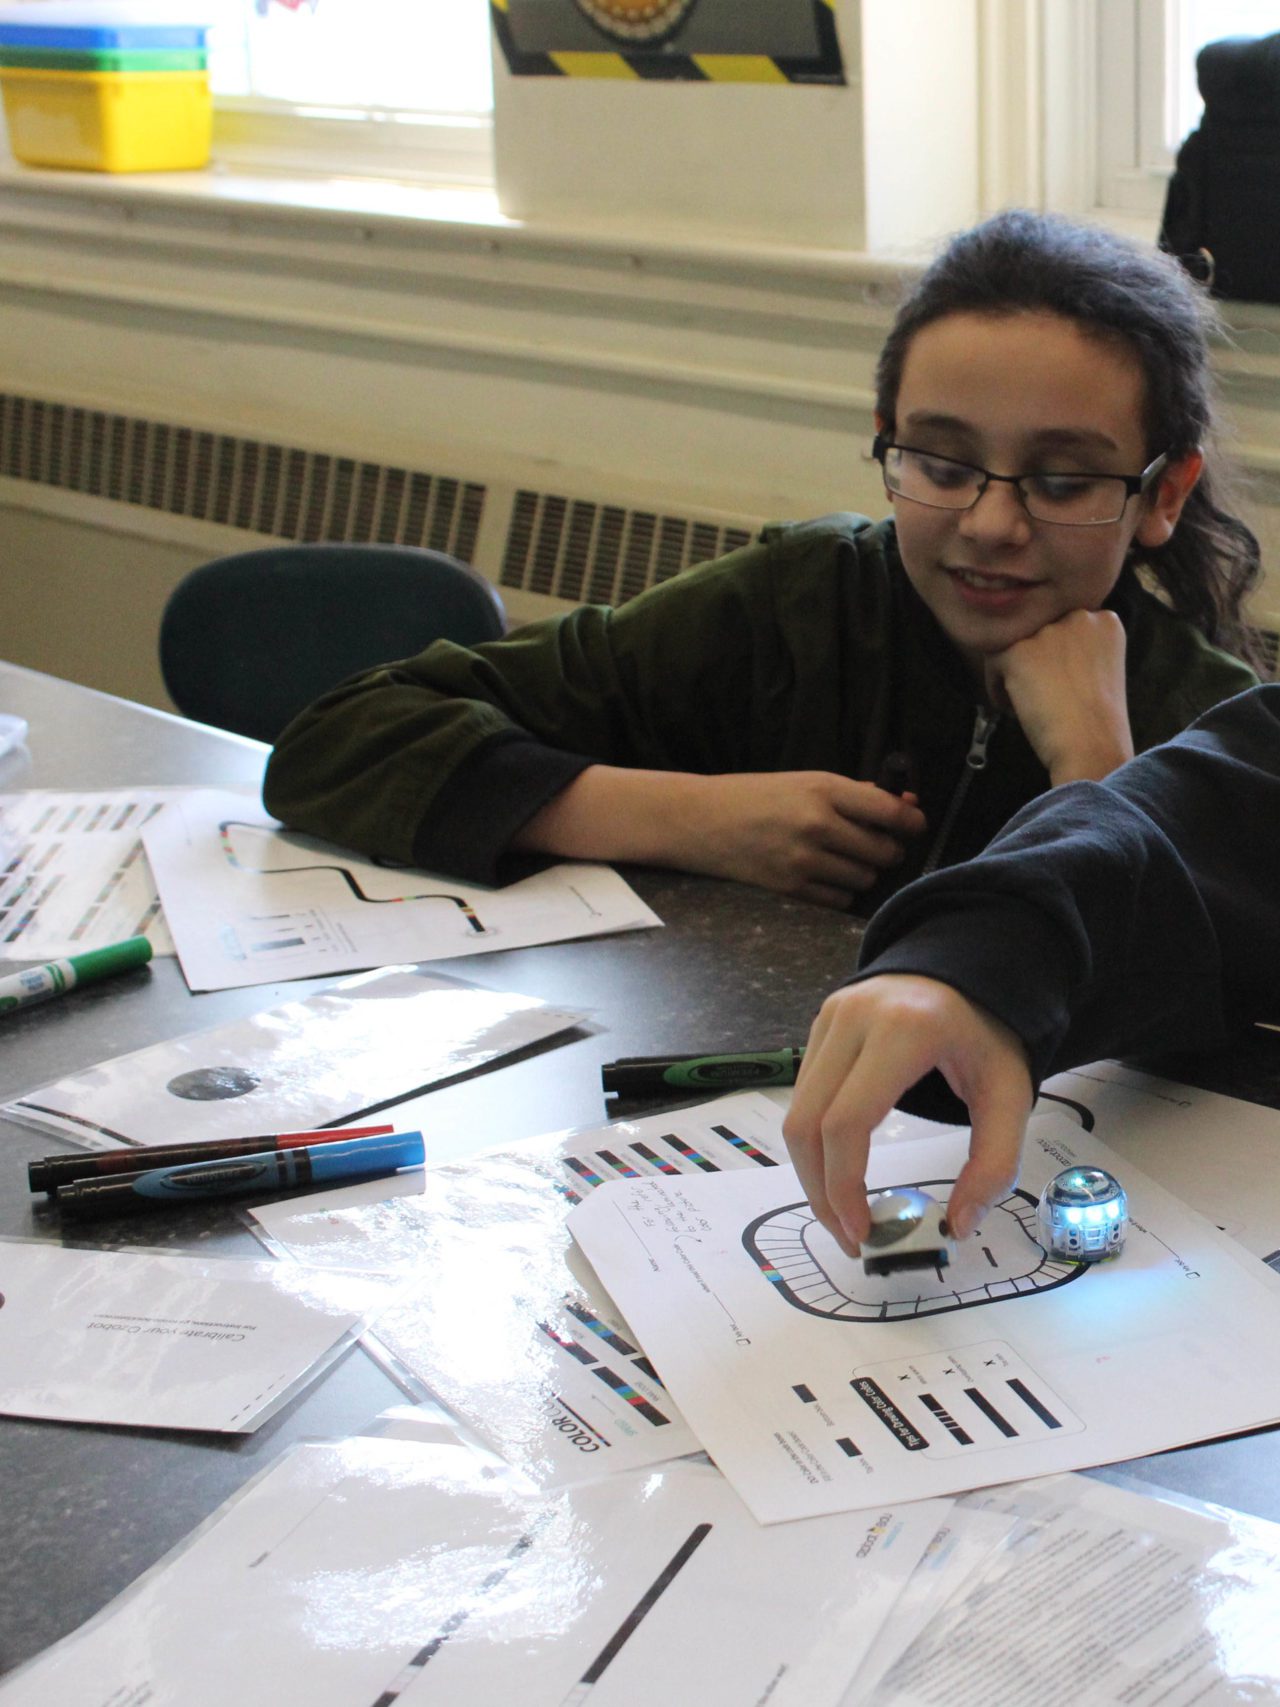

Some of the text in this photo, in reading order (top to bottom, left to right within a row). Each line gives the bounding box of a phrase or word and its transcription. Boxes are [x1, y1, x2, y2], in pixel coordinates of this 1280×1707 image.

[85, 1321, 142, 1334] Ozobot
[179, 1328, 246, 1343] Calibrate
[859, 1380, 921, 1447] Tips for Drawing Color Codes
[552, 1416, 600, 1453] COLOR
